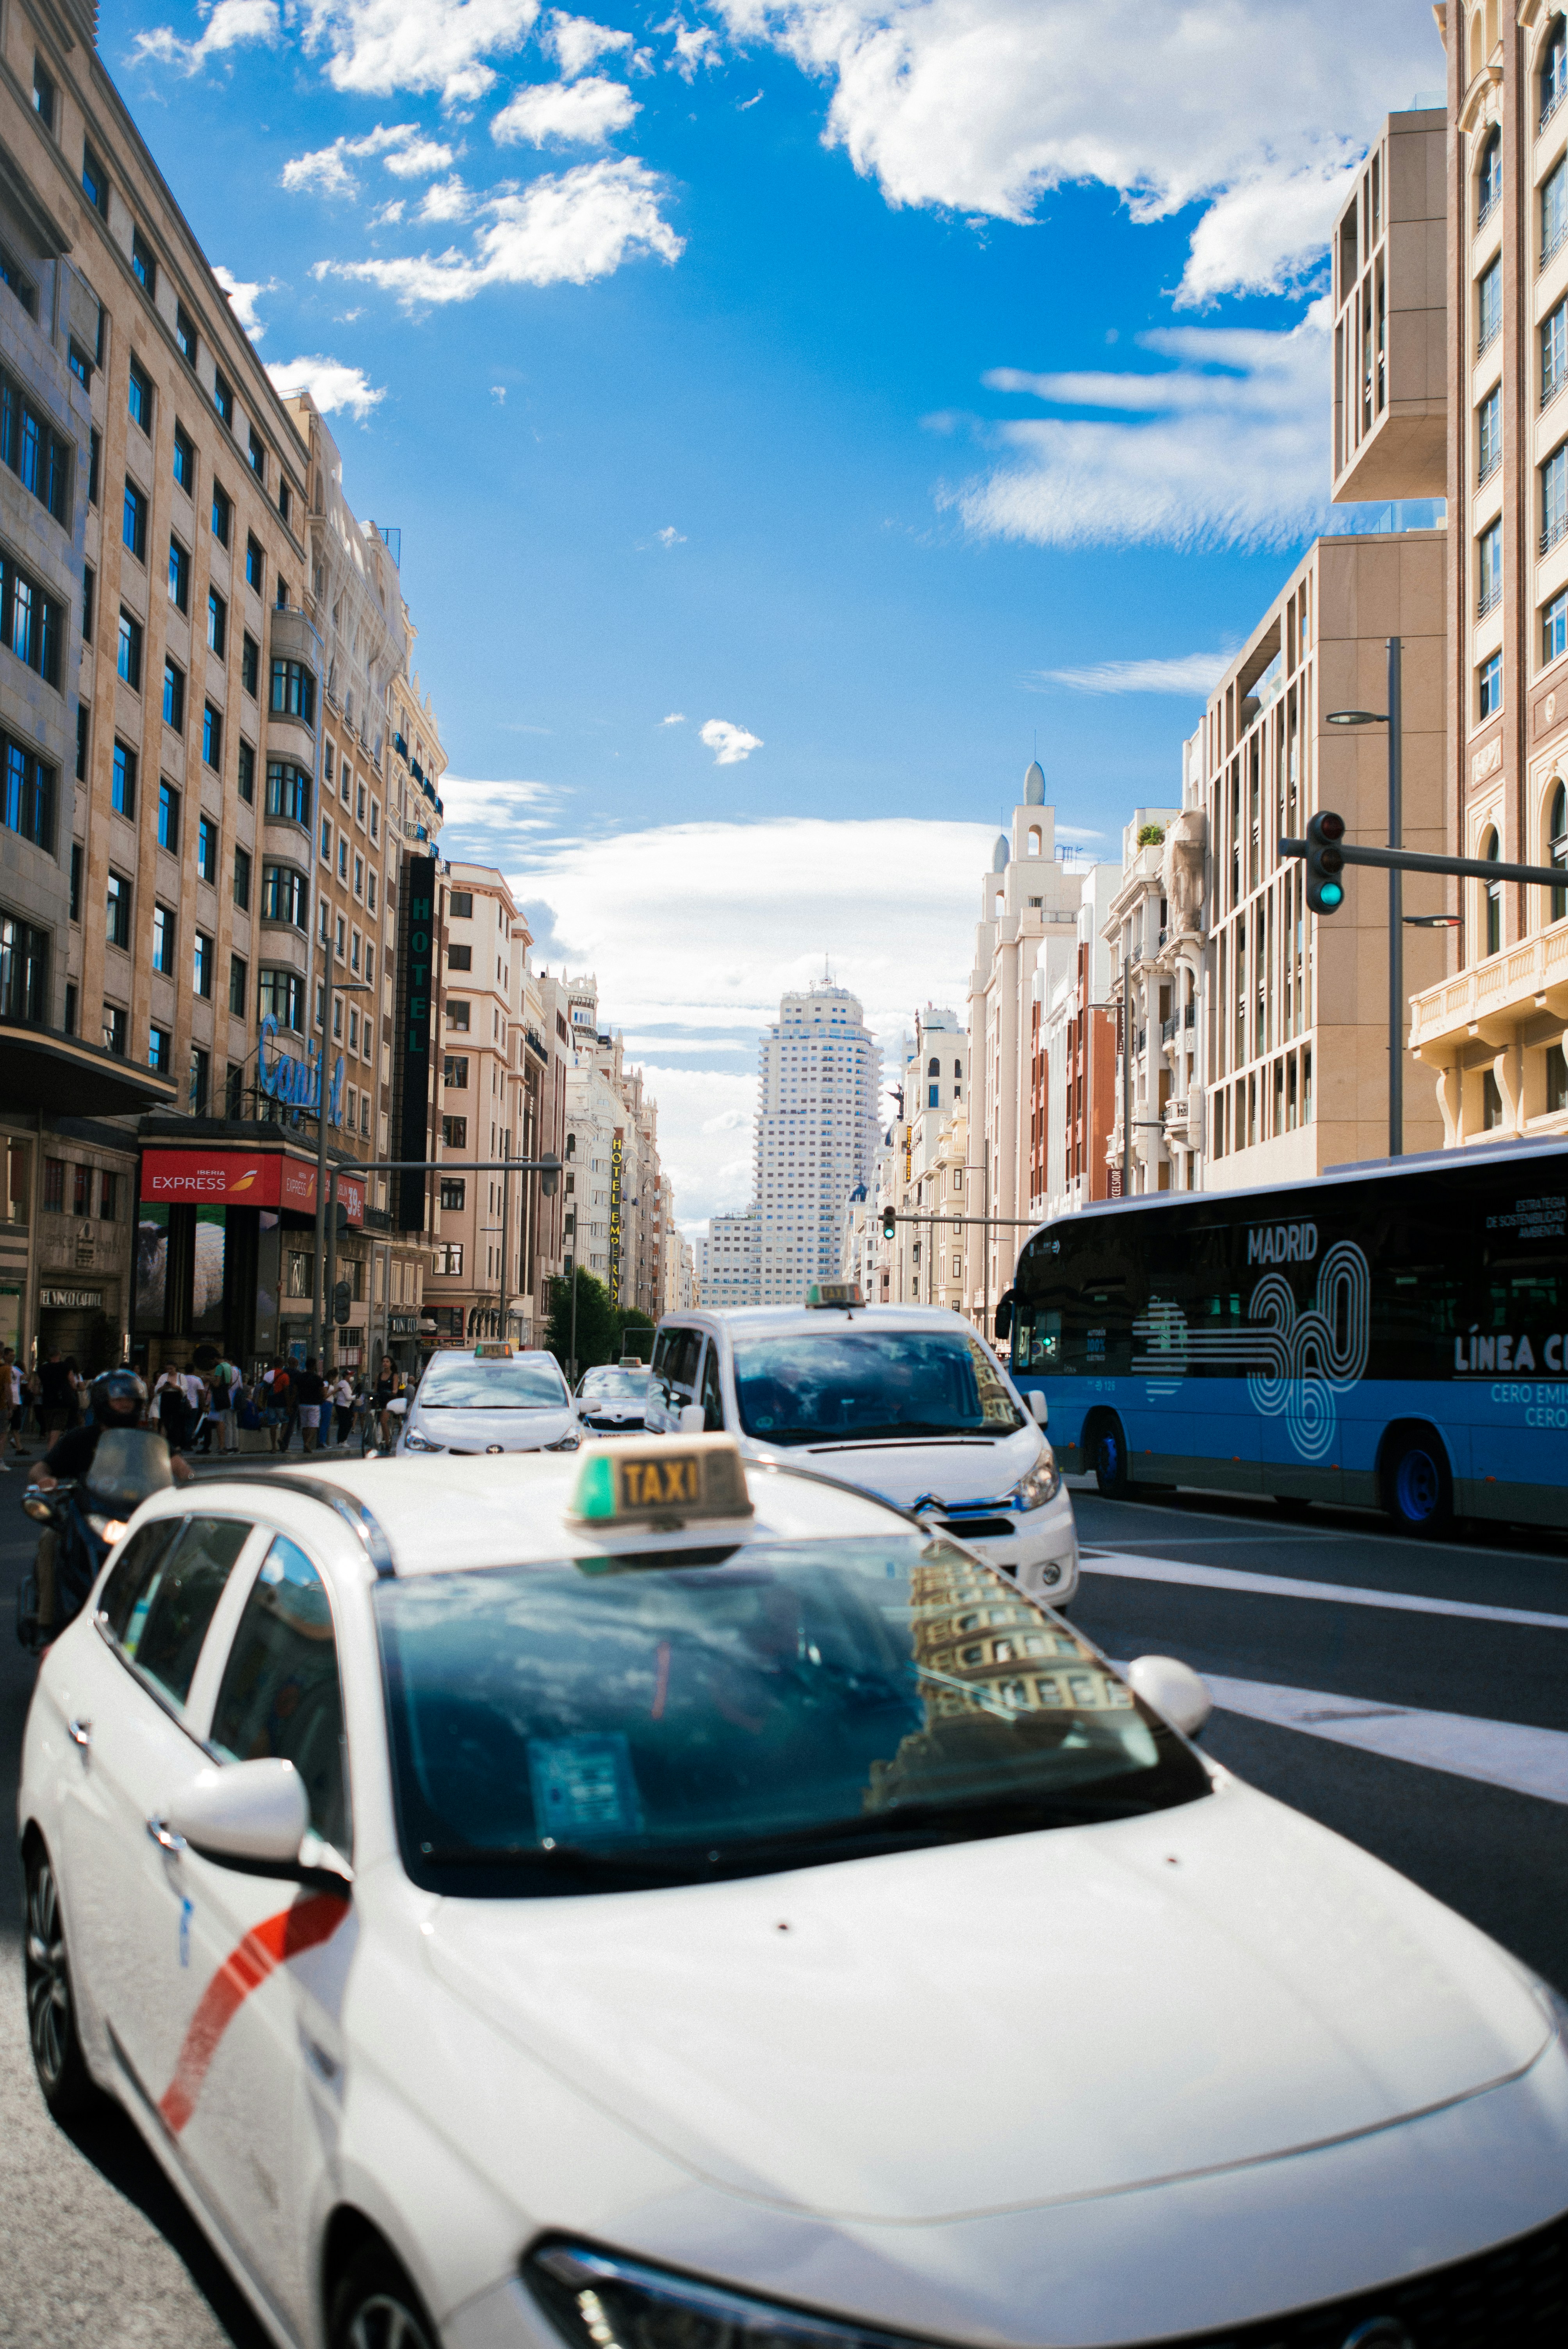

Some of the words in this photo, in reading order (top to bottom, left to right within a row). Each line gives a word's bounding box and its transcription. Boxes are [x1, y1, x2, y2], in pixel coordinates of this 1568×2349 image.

[409, 898, 429, 1052] HOTEL
[612, 1139, 622, 1204] HOTEL
[153, 1177, 225, 1190] EXPRESS
[287, 1178, 306, 1196] EXPRESS
[1486, 1216, 1498, 1228] DE
[1247, 1223, 1318, 1265] MADRID
[1087, 1338, 1105, 1352] 100%
[1455, 1323, 1535, 1371] LÍNEA
[1544, 1333, 1568, 1371] C
[1491, 1384, 1532, 1403] CERO
[1525, 1408, 1568, 1427] CERO
[624, 1462, 698, 1504] TAXI
